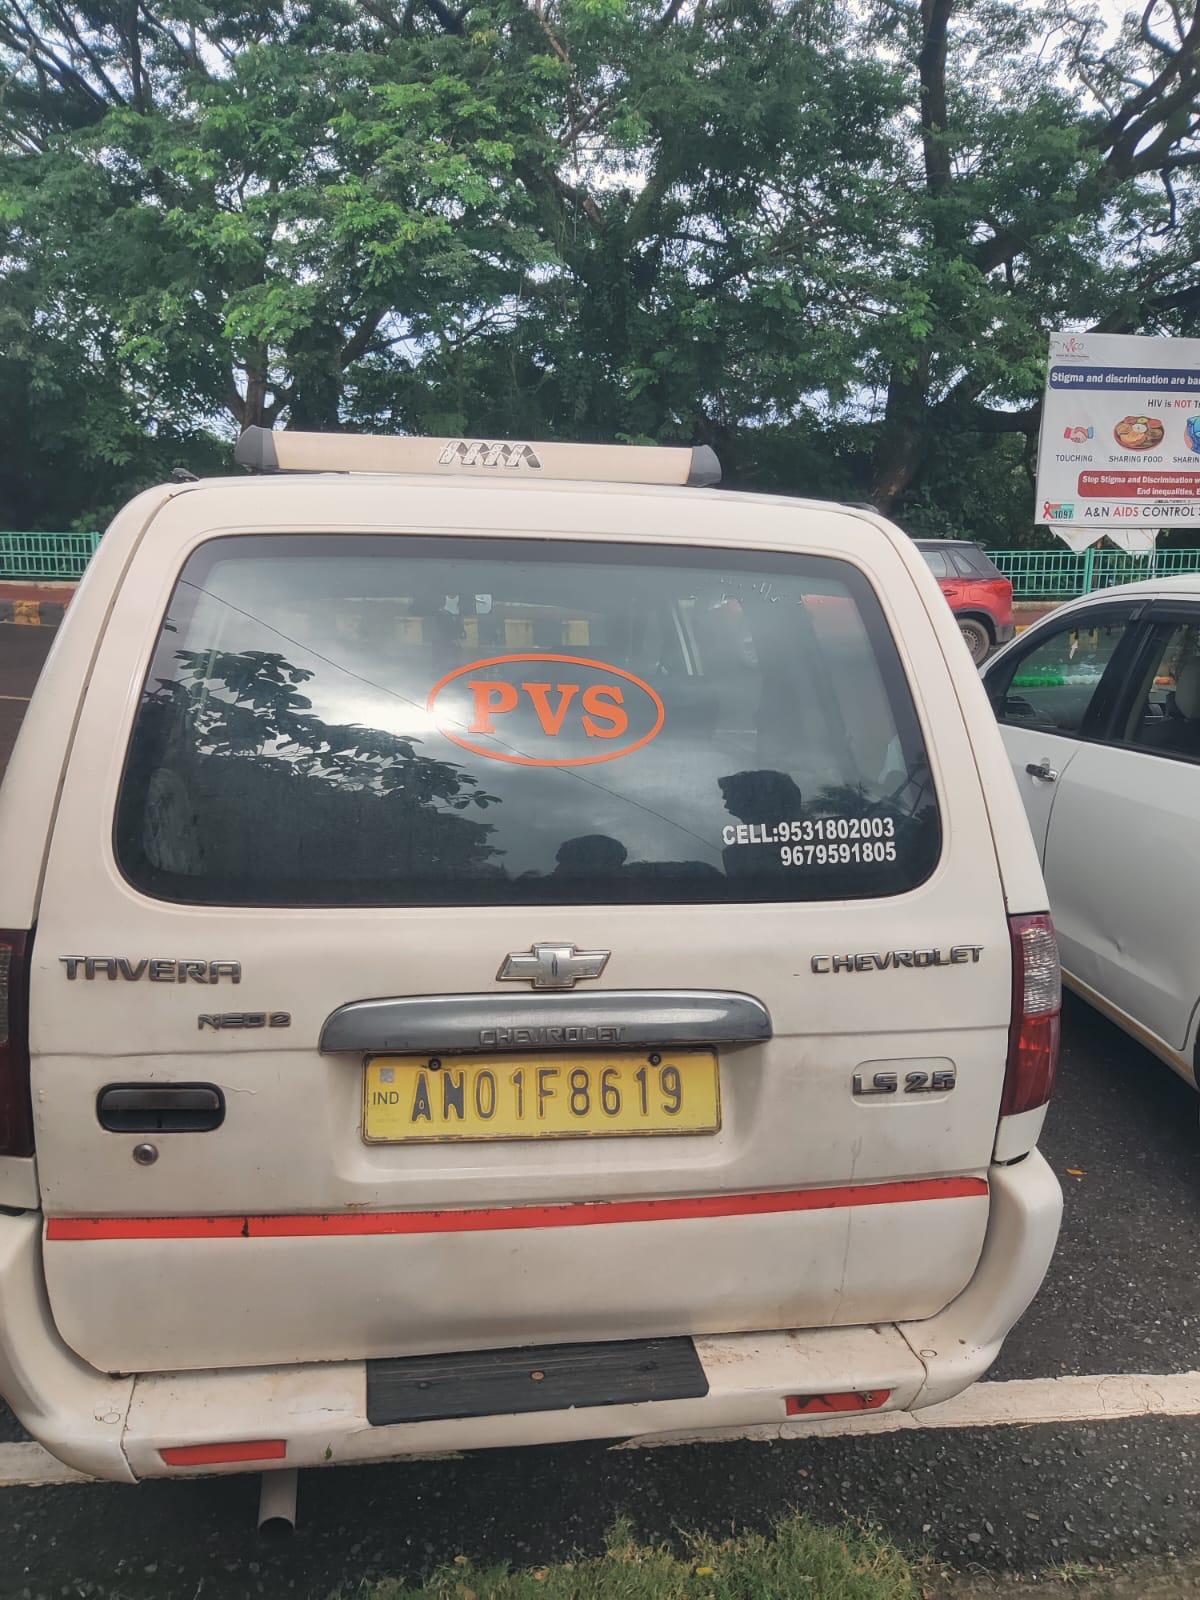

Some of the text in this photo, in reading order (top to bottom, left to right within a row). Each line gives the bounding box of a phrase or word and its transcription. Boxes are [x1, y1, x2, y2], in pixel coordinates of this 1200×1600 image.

[1051, 372, 1084, 384] Stigma
[1086, 374, 1104, 383] and
[1105, 374, 1169, 385] discrimination
[1170, 376, 1186, 385] are
[1147, 399, 1163, 408] HIV
[1164, 399, 1172, 408] is
[1173, 399, 1193, 409] NOT
[1055, 454, 1093, 463] TOUCHING
[1108, 455, 1164, 464] SHARING FOOD
[1081, 475, 1100, 485] Stop
[1100, 475, 1126, 485] Stigma
[1127, 476, 1142, 484] and
[1142, 475, 1193, 484] Discrimination
[1136, 487, 1151, 495] End
[1151, 487, 1195, 497] inequalities,
[1054, 510, 1074, 520] 1097
[1084, 506, 1110, 518] A&N
[1112, 506, 1139, 518] AIDS
[1142, 506, 1195, 518] CONTROL
[466, 680, 629, 740] PVS
[721, 816, 896, 846] CELL:9531802003
[780, 841, 897, 867] 9679591805
[810, 944, 985, 974] CHEVROLET
[58, 954, 243, 985] TAVERA
[268, 1011, 292, 1029] 2
[479, 1025, 626, 1046] CHEVROLET
[852, 1072, 899, 1096] LS
[372, 1090, 400, 1106] IND
[410, 1067, 683, 1122] AN01F8619
